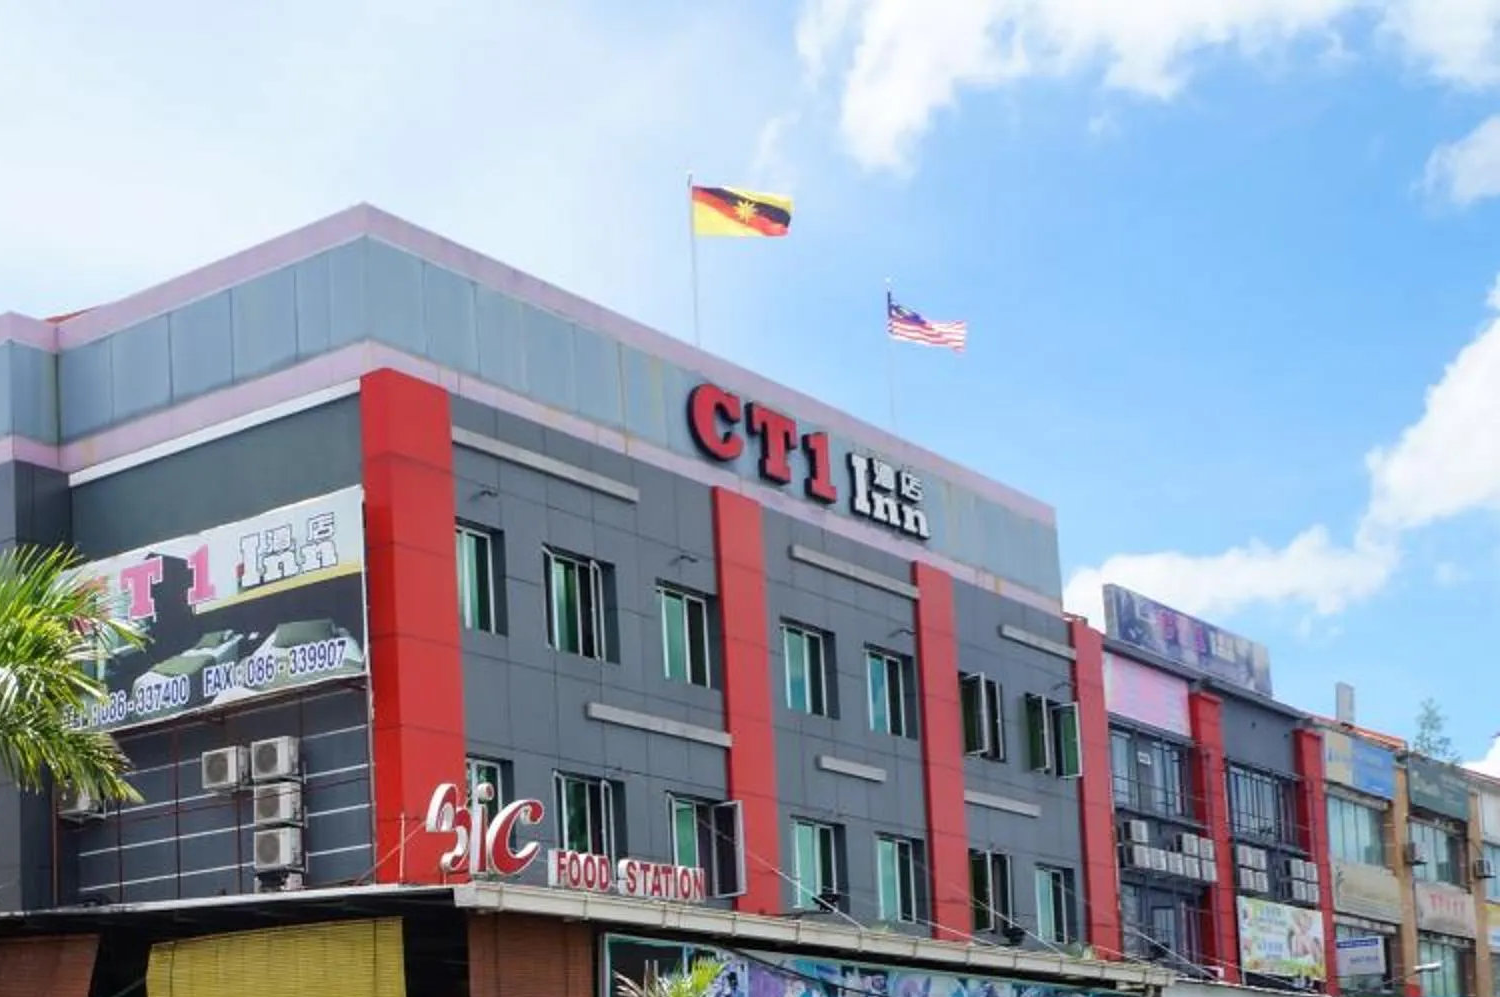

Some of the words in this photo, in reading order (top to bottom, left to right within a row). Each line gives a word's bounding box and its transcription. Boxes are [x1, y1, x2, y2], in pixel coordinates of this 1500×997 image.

[688, 383, 838, 504] CT1
[849, 451, 932, 540] Inn
[555, 850, 611, 891] FOOD
[626, 860, 706, 899] STATION
